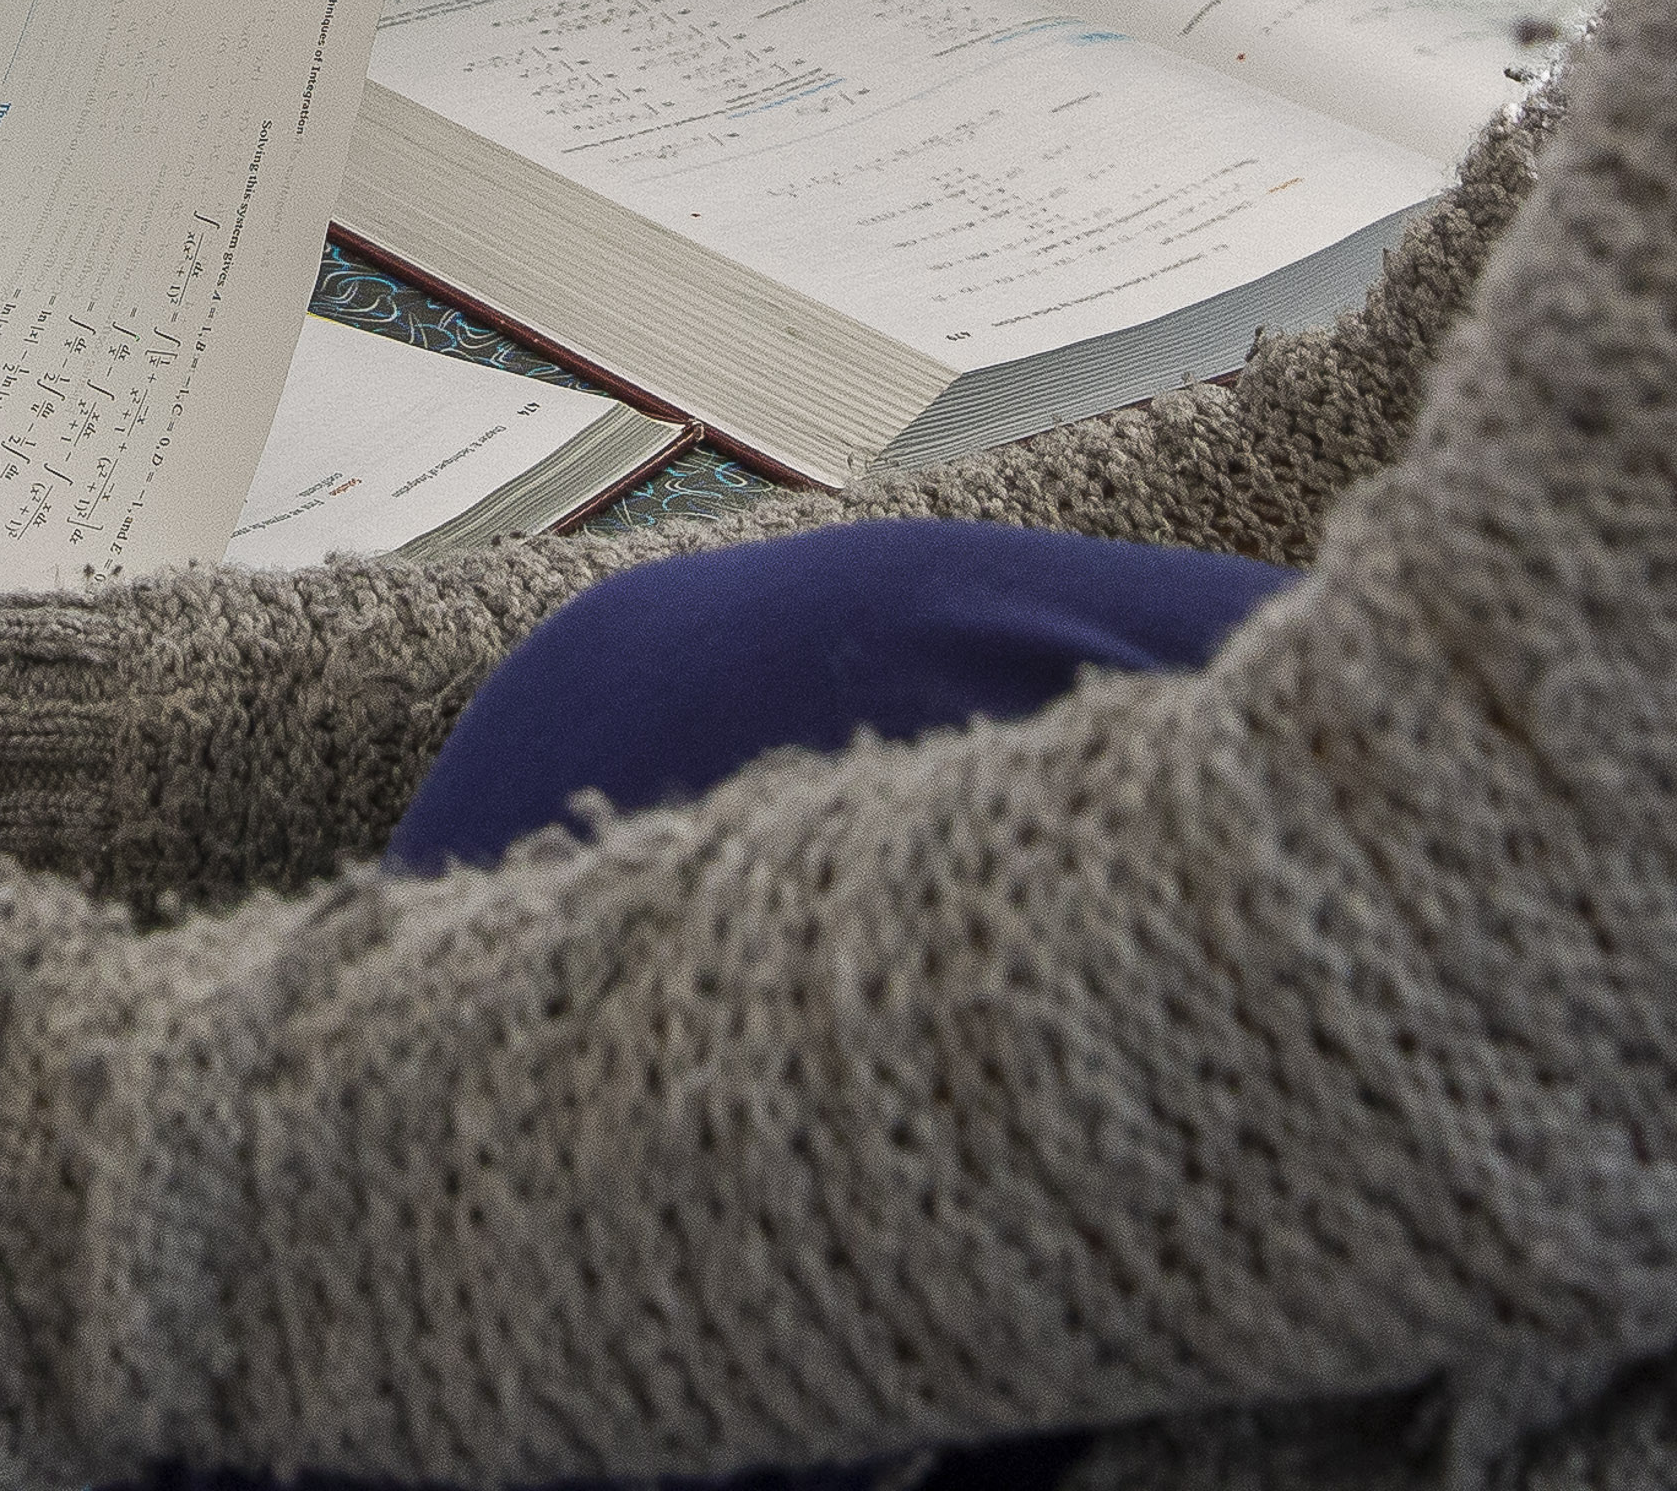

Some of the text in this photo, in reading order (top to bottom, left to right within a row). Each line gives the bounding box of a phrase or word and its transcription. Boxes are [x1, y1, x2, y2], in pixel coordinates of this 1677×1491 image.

[312, 48, 324, 64] of
[295, 65, 322, 136] Integration
[248, 119, 274, 173] Solving
[242, 174, 259, 200] this
[227, 202, 249, 250] system
[215, 251, 235, 288] gives
[211, 288, 222, 302] A
[196, 325, 213, 338] 1,
